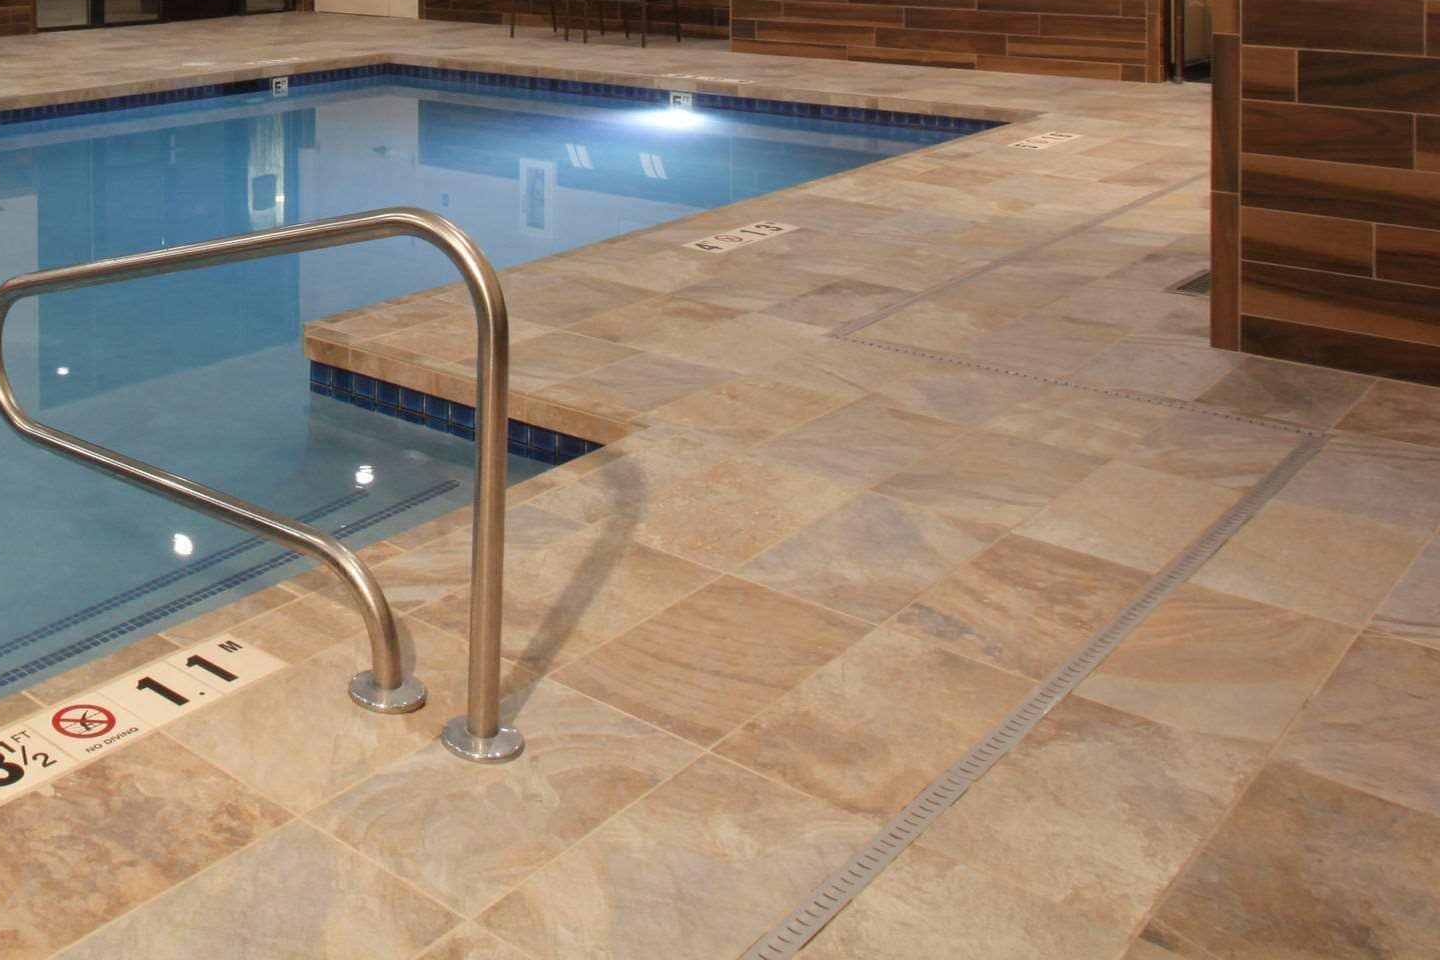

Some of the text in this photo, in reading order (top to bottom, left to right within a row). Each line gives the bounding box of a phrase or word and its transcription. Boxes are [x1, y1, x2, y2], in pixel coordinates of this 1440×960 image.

[217, 639, 244, 654] M
[10, 729, 32, 744] FT
[85, 726, 140, 753] NO DIVING
